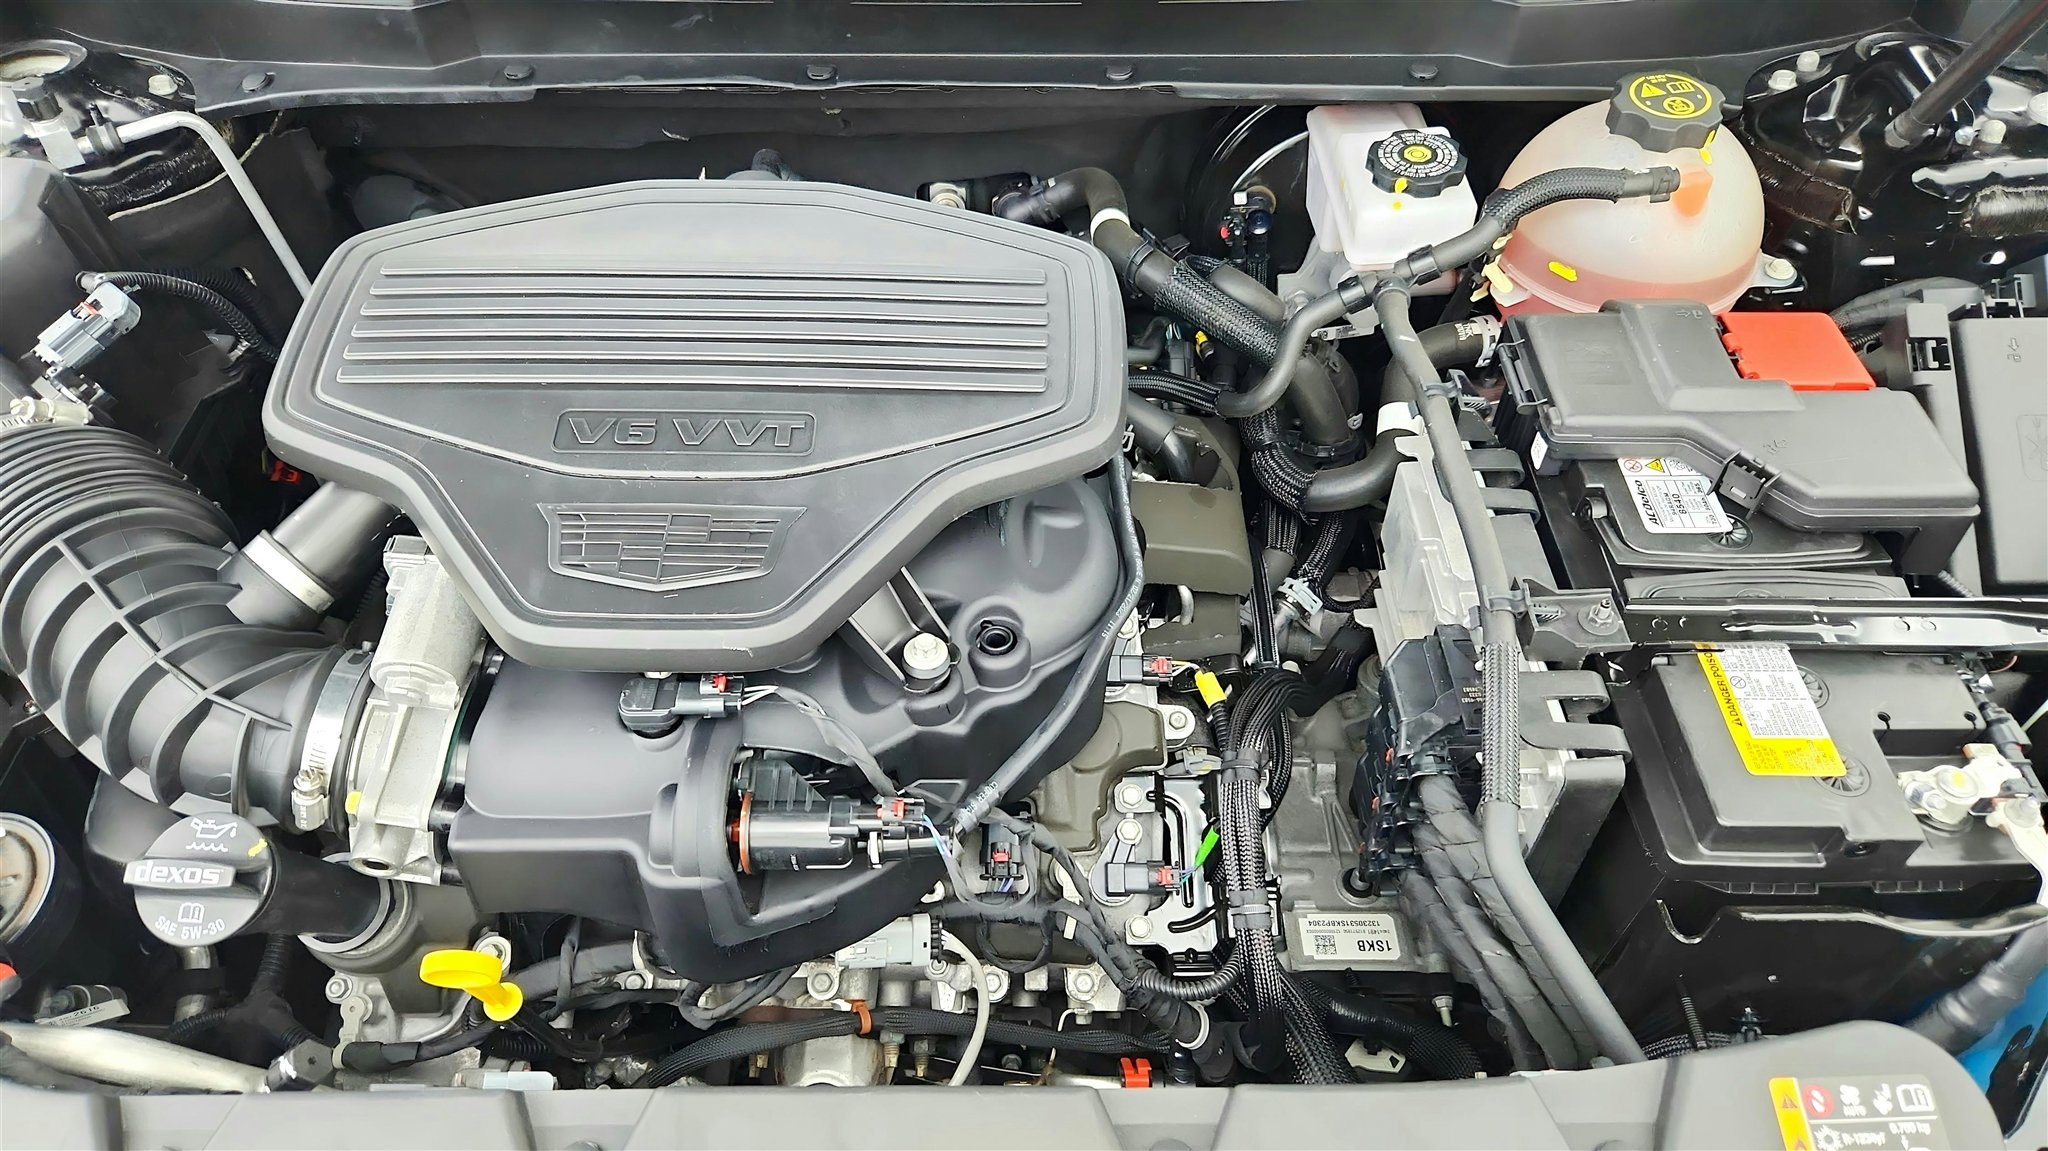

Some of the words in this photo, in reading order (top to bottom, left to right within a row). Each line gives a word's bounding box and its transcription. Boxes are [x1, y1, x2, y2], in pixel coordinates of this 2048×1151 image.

[568, 417, 657, 444] V6
[672, 418, 806, 447] VVT
[1634, 480, 1660, 527] ACDelco
[1672, 493, 1688, 515] 8540
[134, 860, 220, 884] dexos
[155, 915, 178, 936] SAE
[181, 918, 226, 940] 5W-30
[1357, 940, 1393, 952] 1SKB
